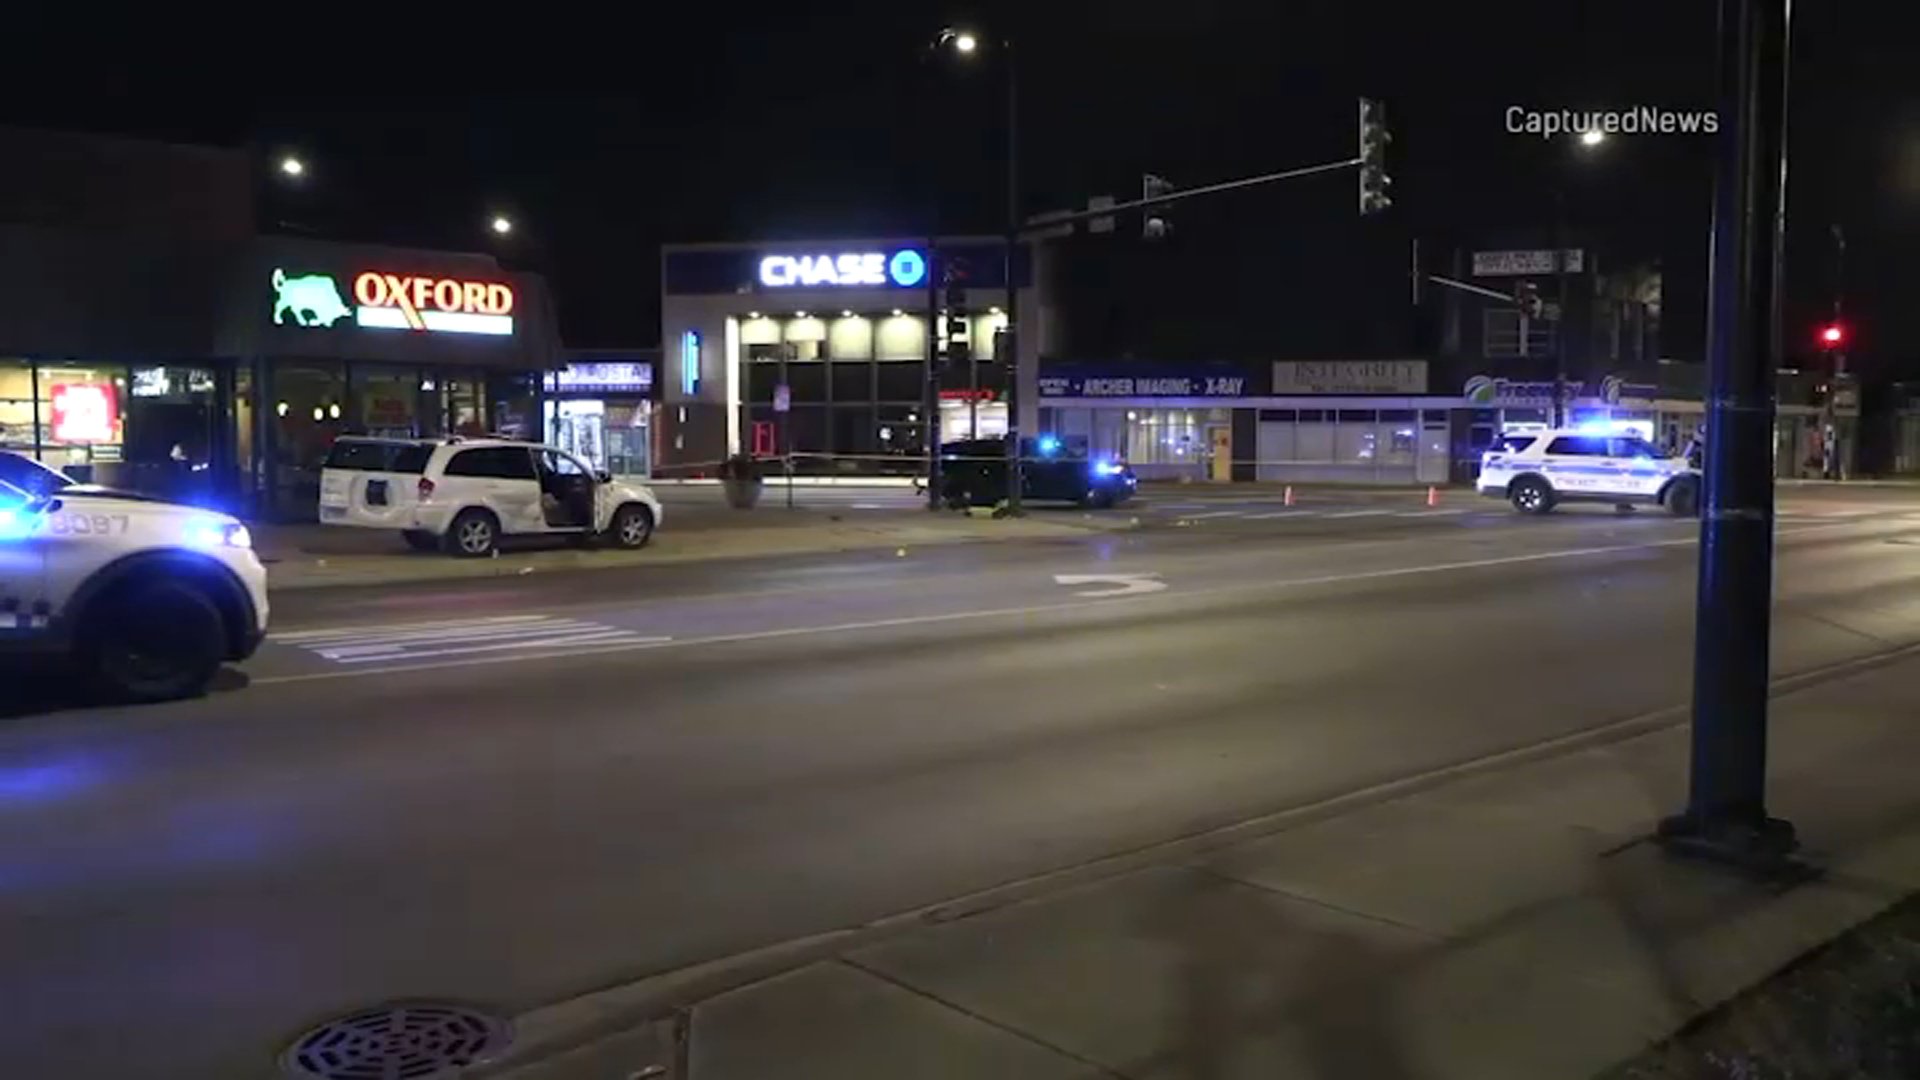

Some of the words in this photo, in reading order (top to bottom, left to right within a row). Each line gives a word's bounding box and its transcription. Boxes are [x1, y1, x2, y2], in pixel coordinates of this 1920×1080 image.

[760, 253, 887, 287] CHASE
[353, 270, 515, 329] OXFORD
[1082, 377, 1134, 396] ARCHER
[1135, 377, 1191, 396] IMAGING
[1204, 377, 1244, 396] X-RAY
